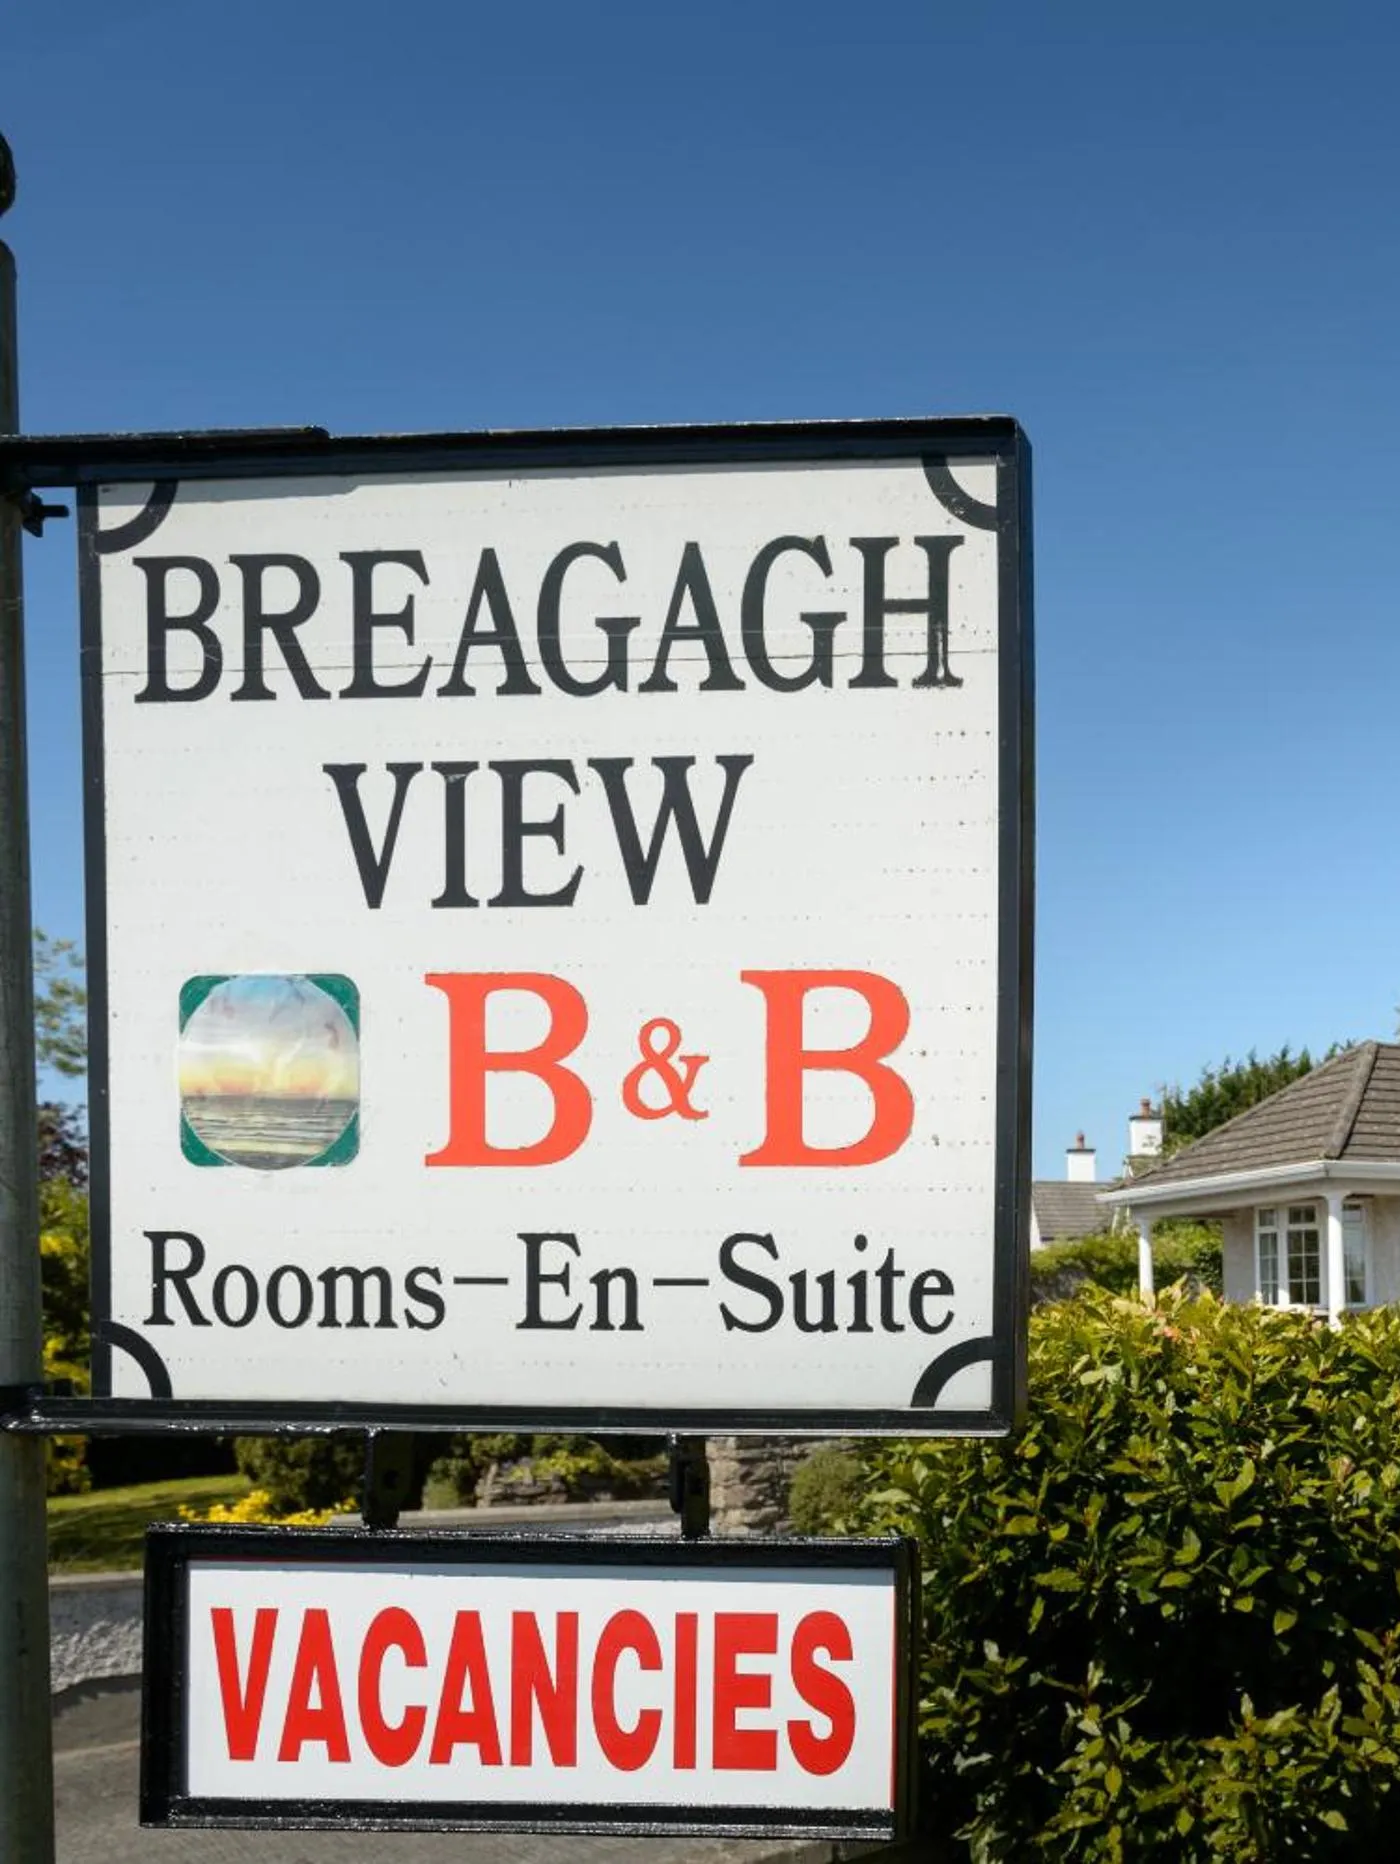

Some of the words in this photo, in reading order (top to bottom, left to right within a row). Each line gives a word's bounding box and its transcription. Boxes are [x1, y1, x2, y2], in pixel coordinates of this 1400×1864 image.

[134, 535, 964, 704] BREAGAGH
[323, 755, 753, 909] VIEW
[211, 1606, 855, 1776] VACANCIES
